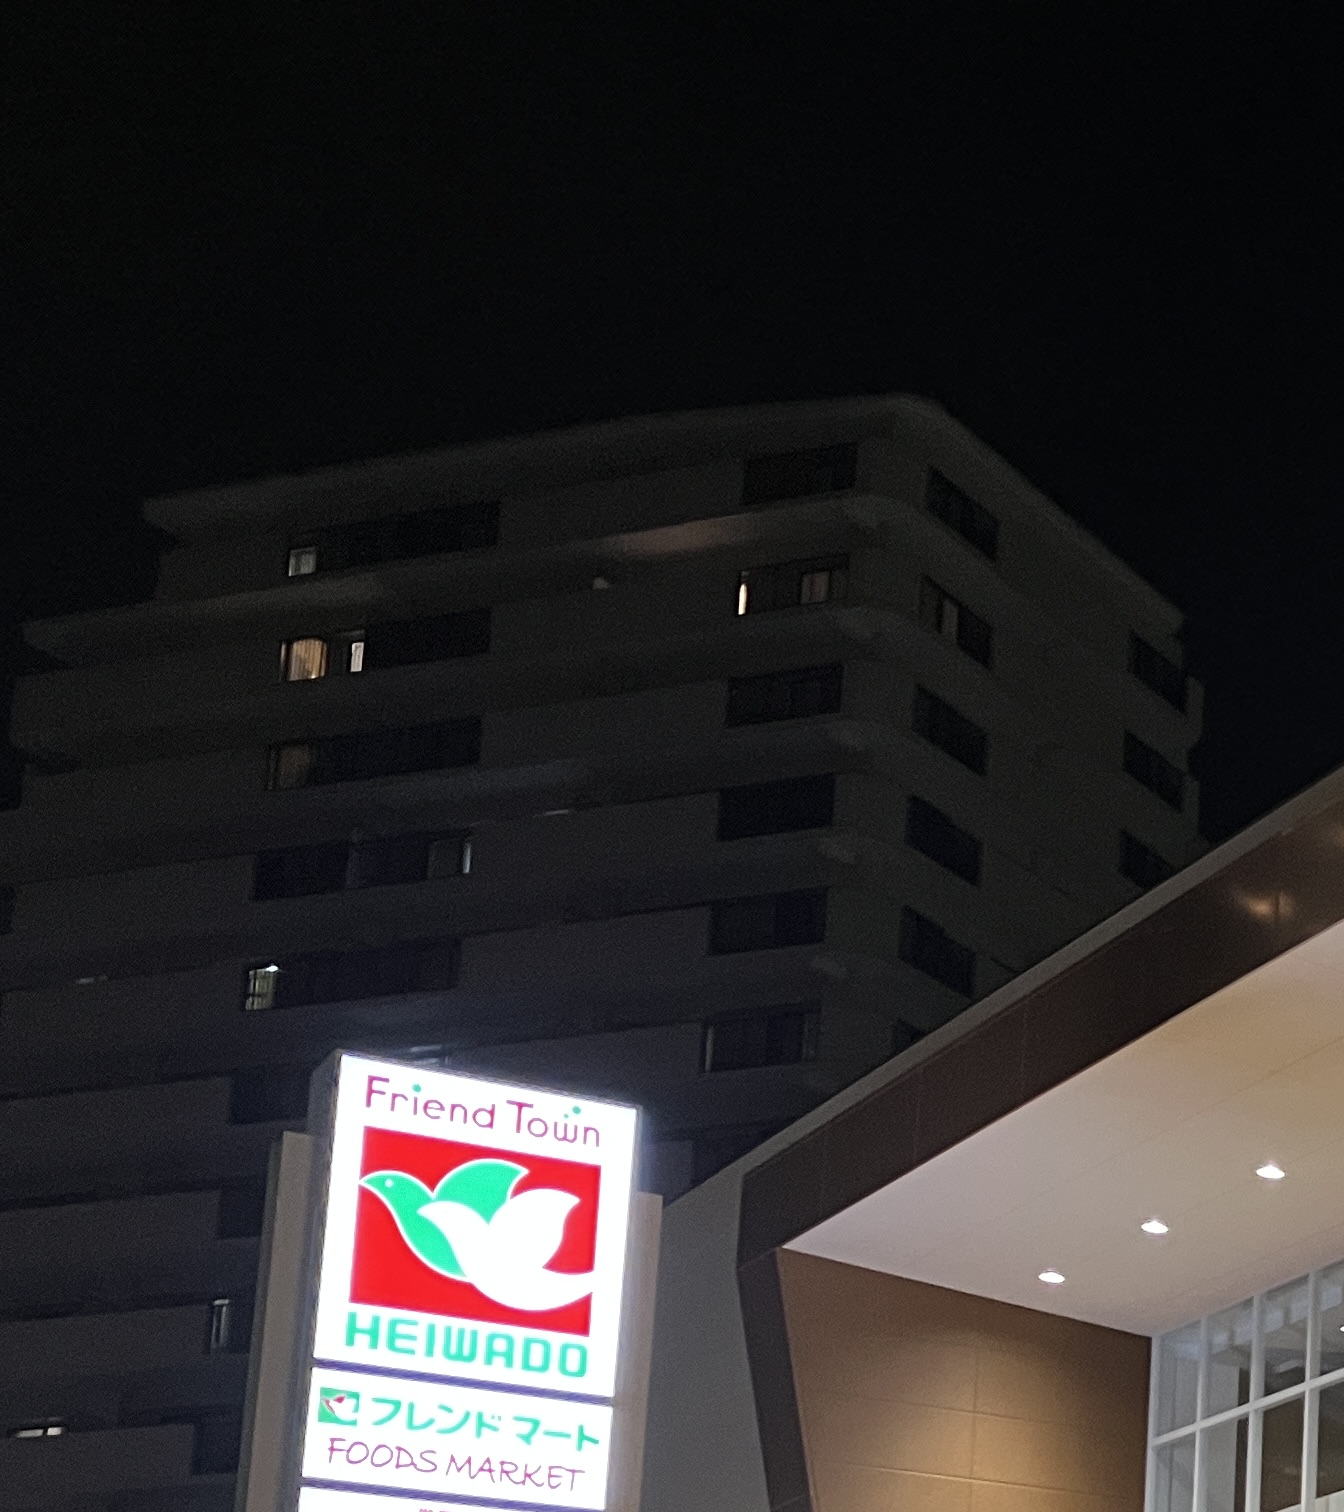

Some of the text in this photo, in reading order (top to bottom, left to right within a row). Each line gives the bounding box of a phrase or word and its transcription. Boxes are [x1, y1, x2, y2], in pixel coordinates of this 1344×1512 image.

[365, 1074, 601, 1148] Friend Town
[344, 1310, 589, 1379] HEIWADO
[327, 1436, 586, 1492] FOODS MARKET
